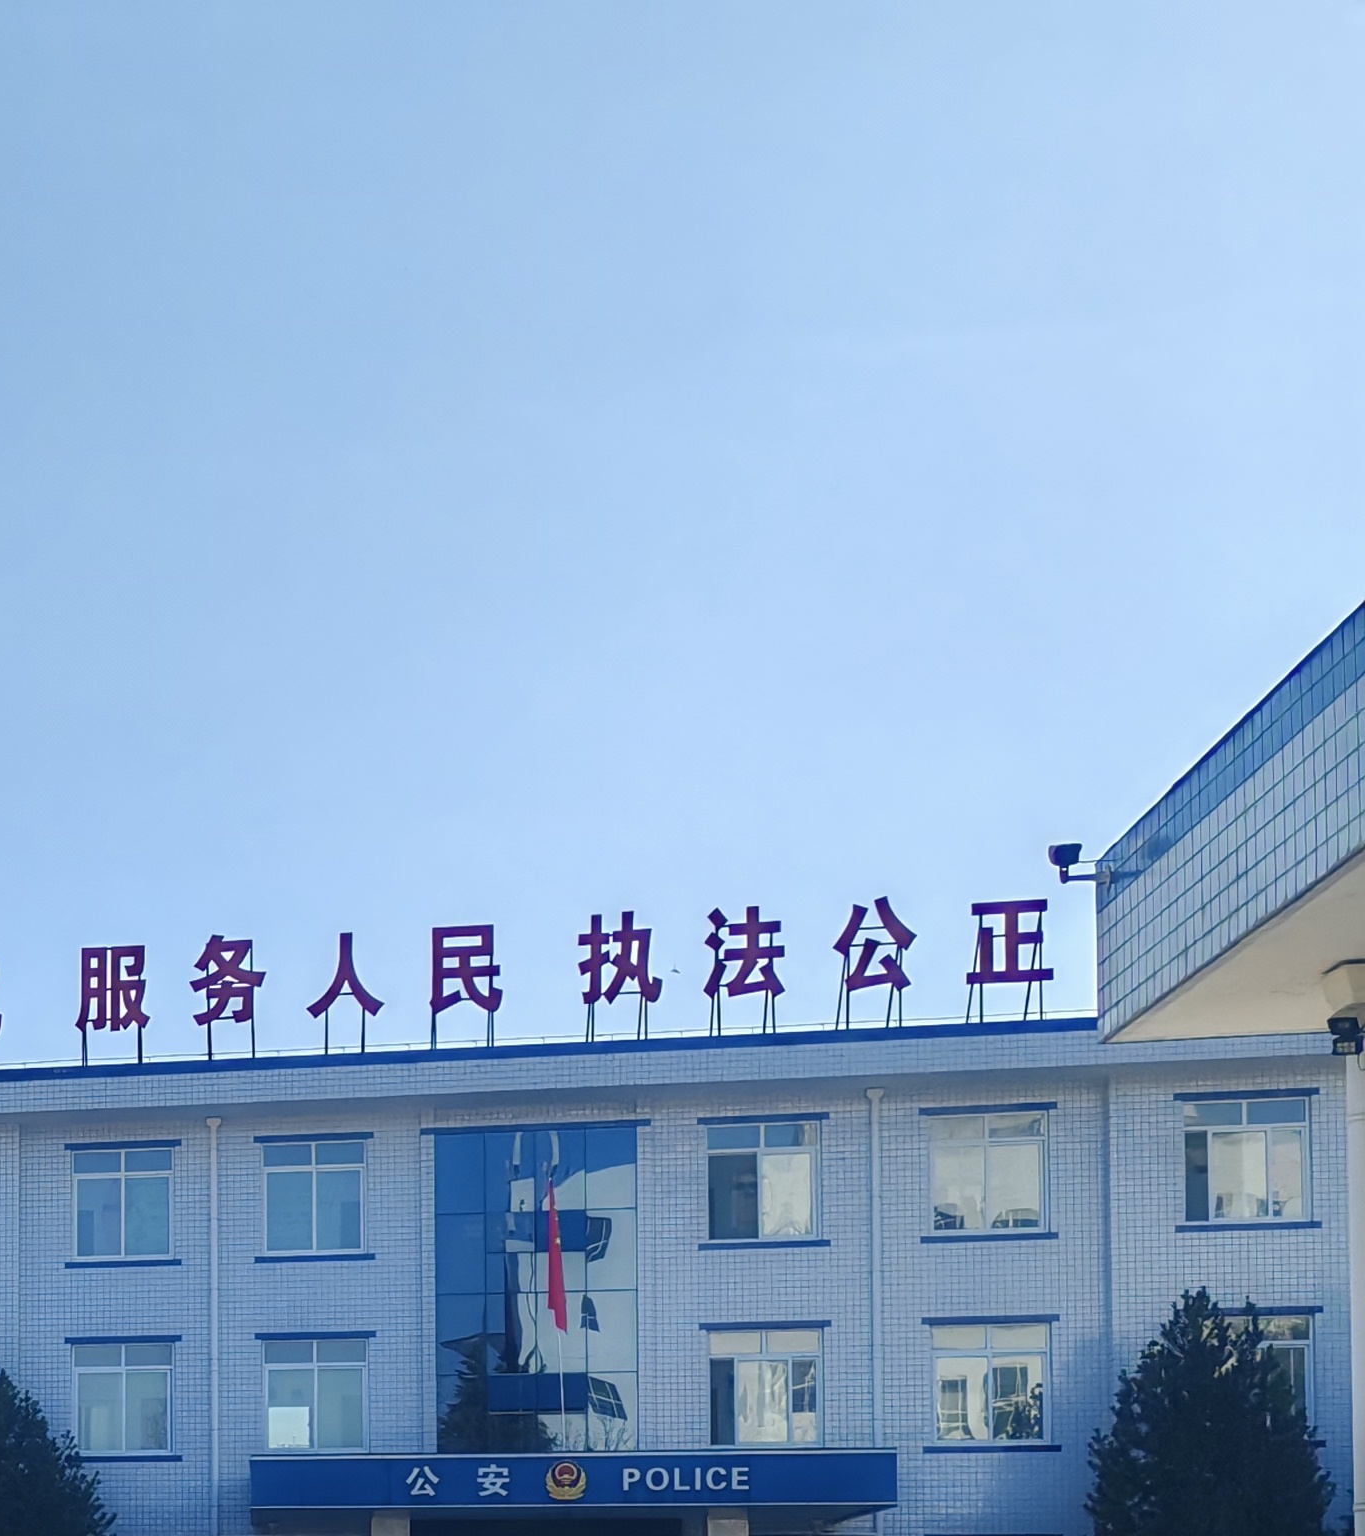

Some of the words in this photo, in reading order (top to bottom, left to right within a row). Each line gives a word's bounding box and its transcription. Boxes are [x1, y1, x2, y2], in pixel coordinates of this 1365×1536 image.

[74, 922, 503, 1031] 服务人民
[576, 895, 1055, 1007] 执法公正
[405, 1464, 511, 1497] 公安
[622, 1466, 751, 1491] POLICE
